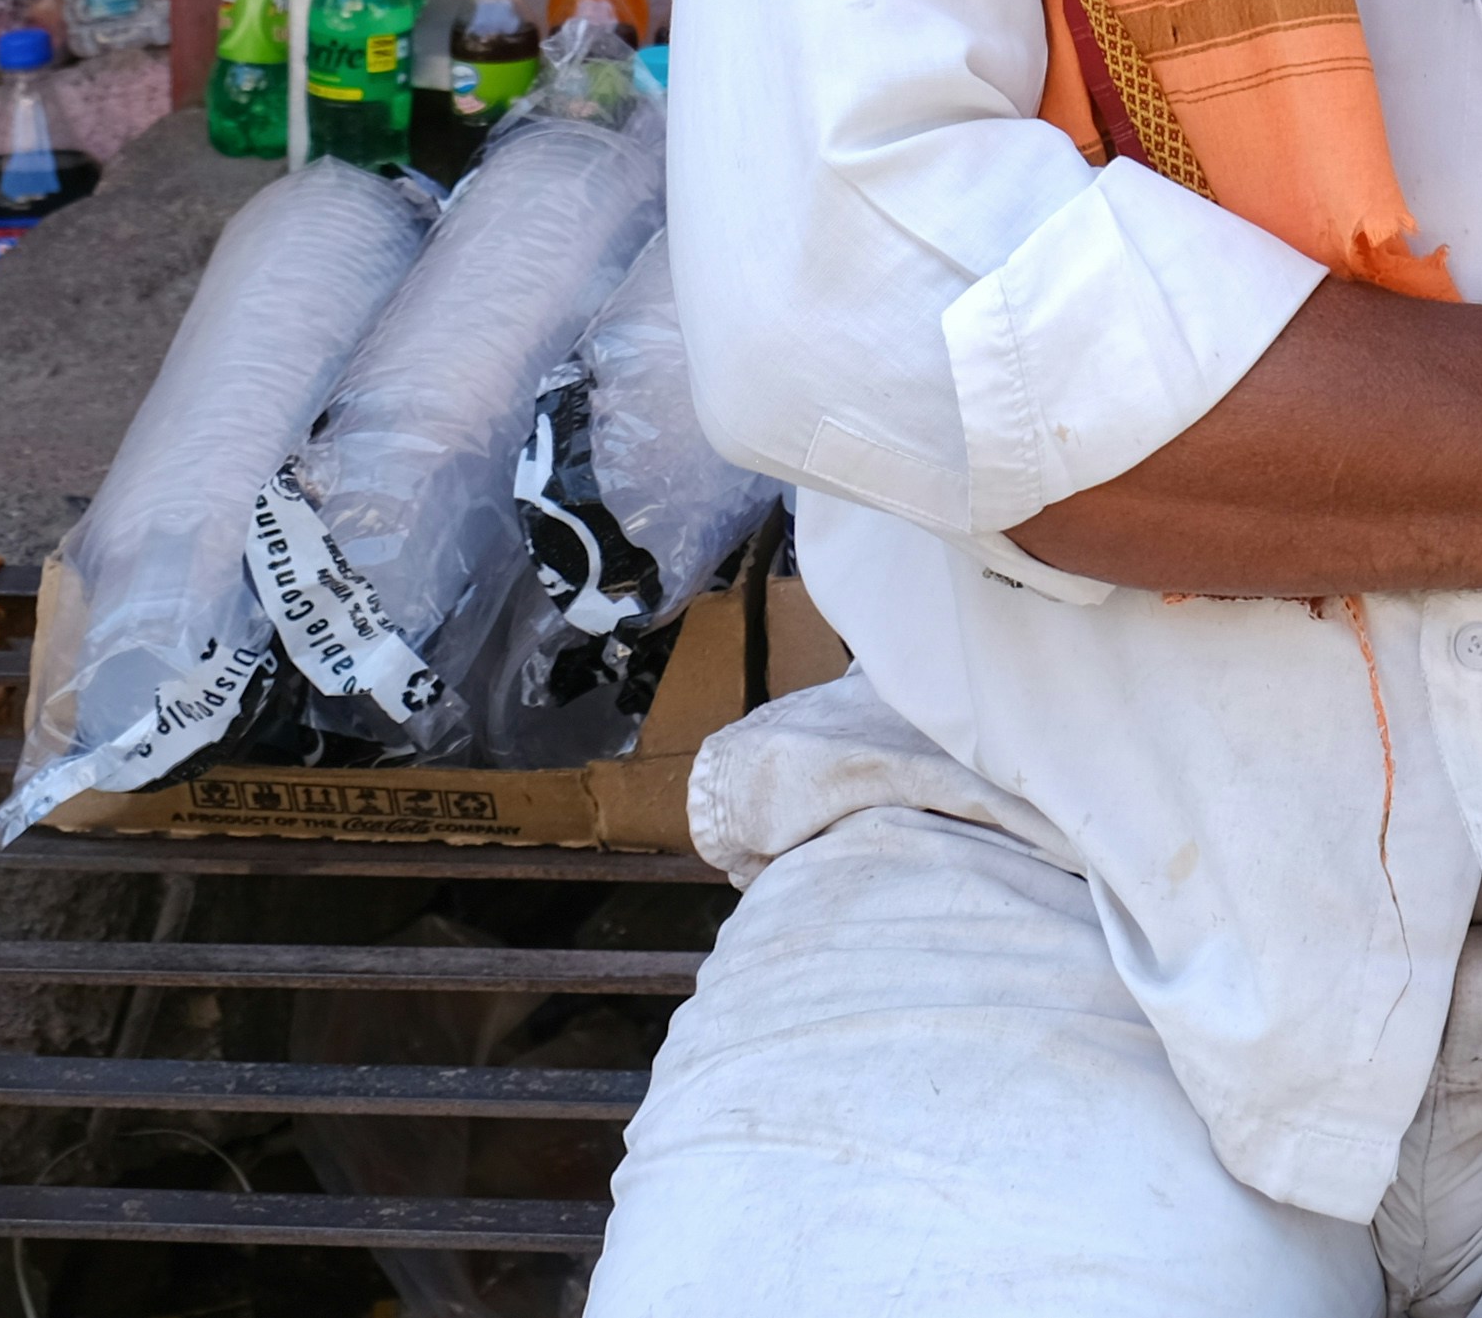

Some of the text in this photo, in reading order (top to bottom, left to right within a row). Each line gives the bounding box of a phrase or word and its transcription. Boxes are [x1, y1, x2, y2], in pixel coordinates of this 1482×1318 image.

[187, 813, 271, 826] PRODUCT
[274, 817, 300, 827] OF
[304, 818, 338, 829] THE
[434, 821, 522, 836] COMPANY
